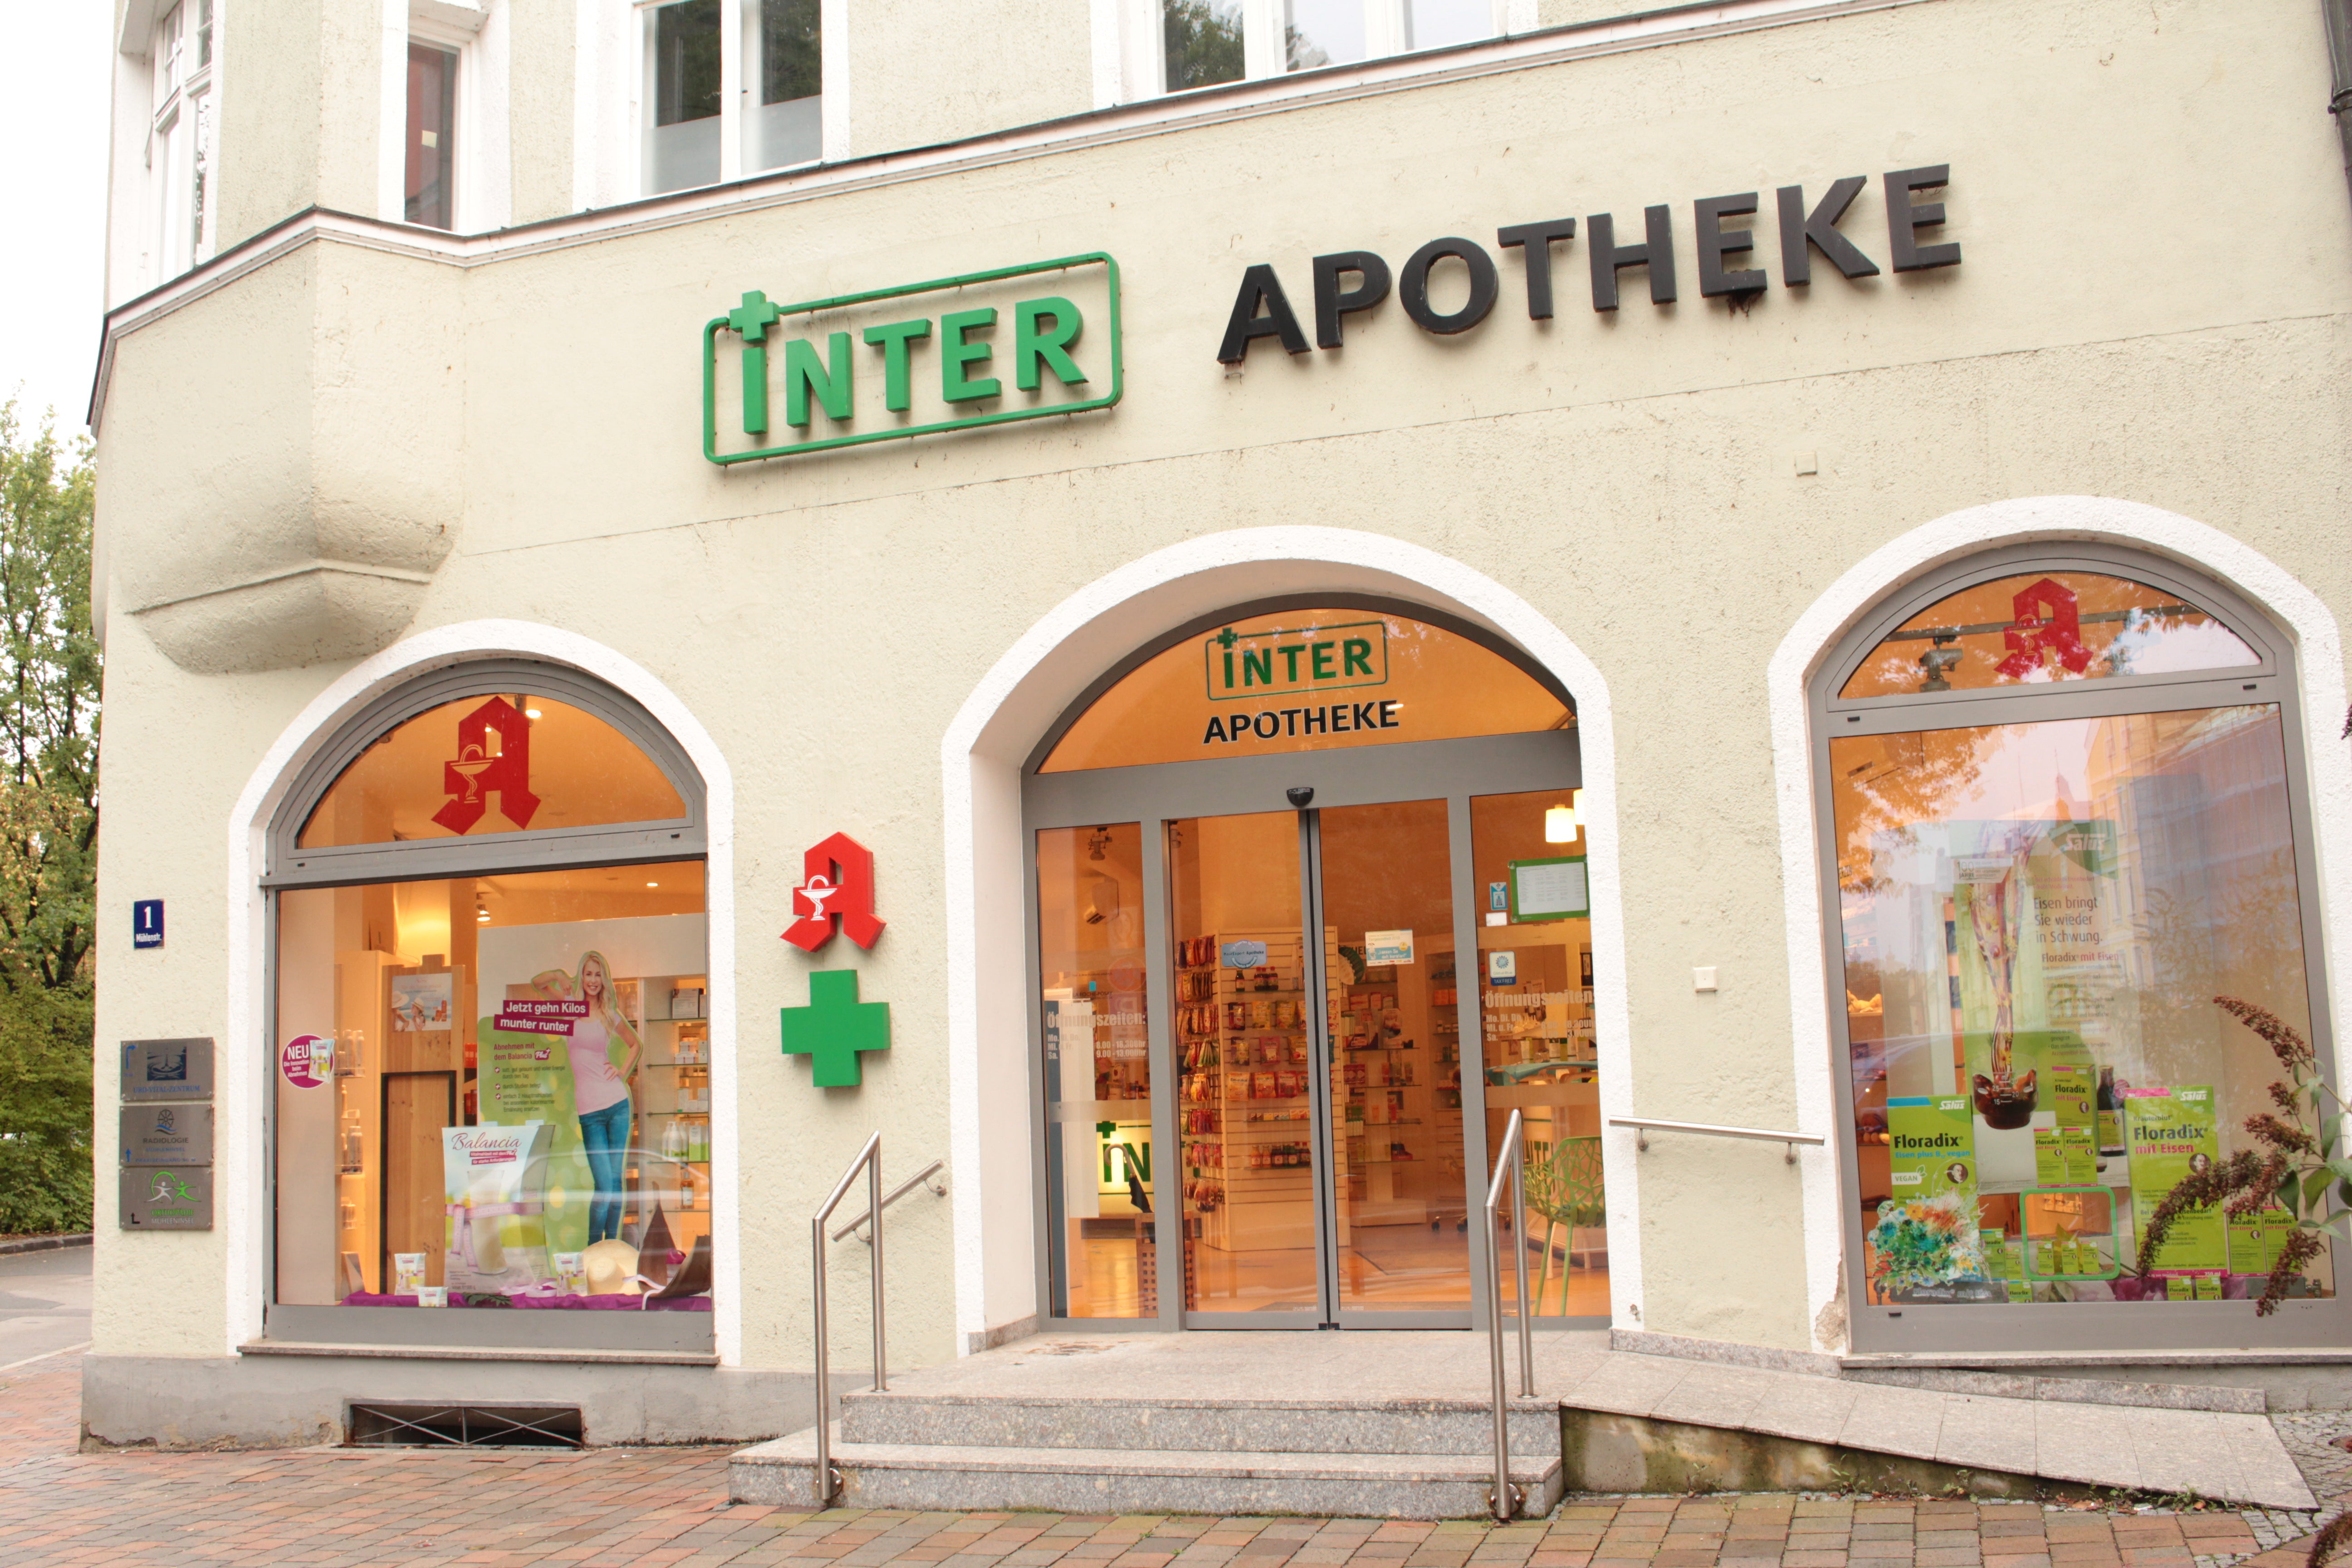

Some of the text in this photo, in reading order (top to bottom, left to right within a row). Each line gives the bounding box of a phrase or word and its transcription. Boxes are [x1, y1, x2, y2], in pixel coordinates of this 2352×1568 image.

[1217, 163, 1961, 364] APOTHEKE
[1203, 700, 1399, 745] APOTHEKE
[2065, 834, 2107, 851] Salus
[2034, 896, 2097, 911] Eisen bringt
[144, 906, 152, 928] 1
[2035, 913, 2092, 926] Sie wieder
[136, 933, 162, 942] Mühlenstr.
[2036, 930, 2102, 945] in Schwung.
[2081, 952, 2094, 961] mit
[2098, 952, 2118, 961] Eisen
[506, 1002, 586, 1015] Jetzt gehn Kilos
[500, 1019, 569, 1032] munter runter
[1487, 1024, 1497, 1032] Mi.
[1487, 1033, 1498, 1041] Sa.
[288, 1044, 309, 1060] NEU
[1096, 1050, 1111, 1058] 9.00
[2055, 1084, 2086, 1093] Floradix
[2180, 1091, 2207, 1101] Salus
[1939, 1100, 1965, 1110] Salus
[451, 1132, 522, 1150] Balancia
[2136, 1142, 2194, 1154] mit Eisen
